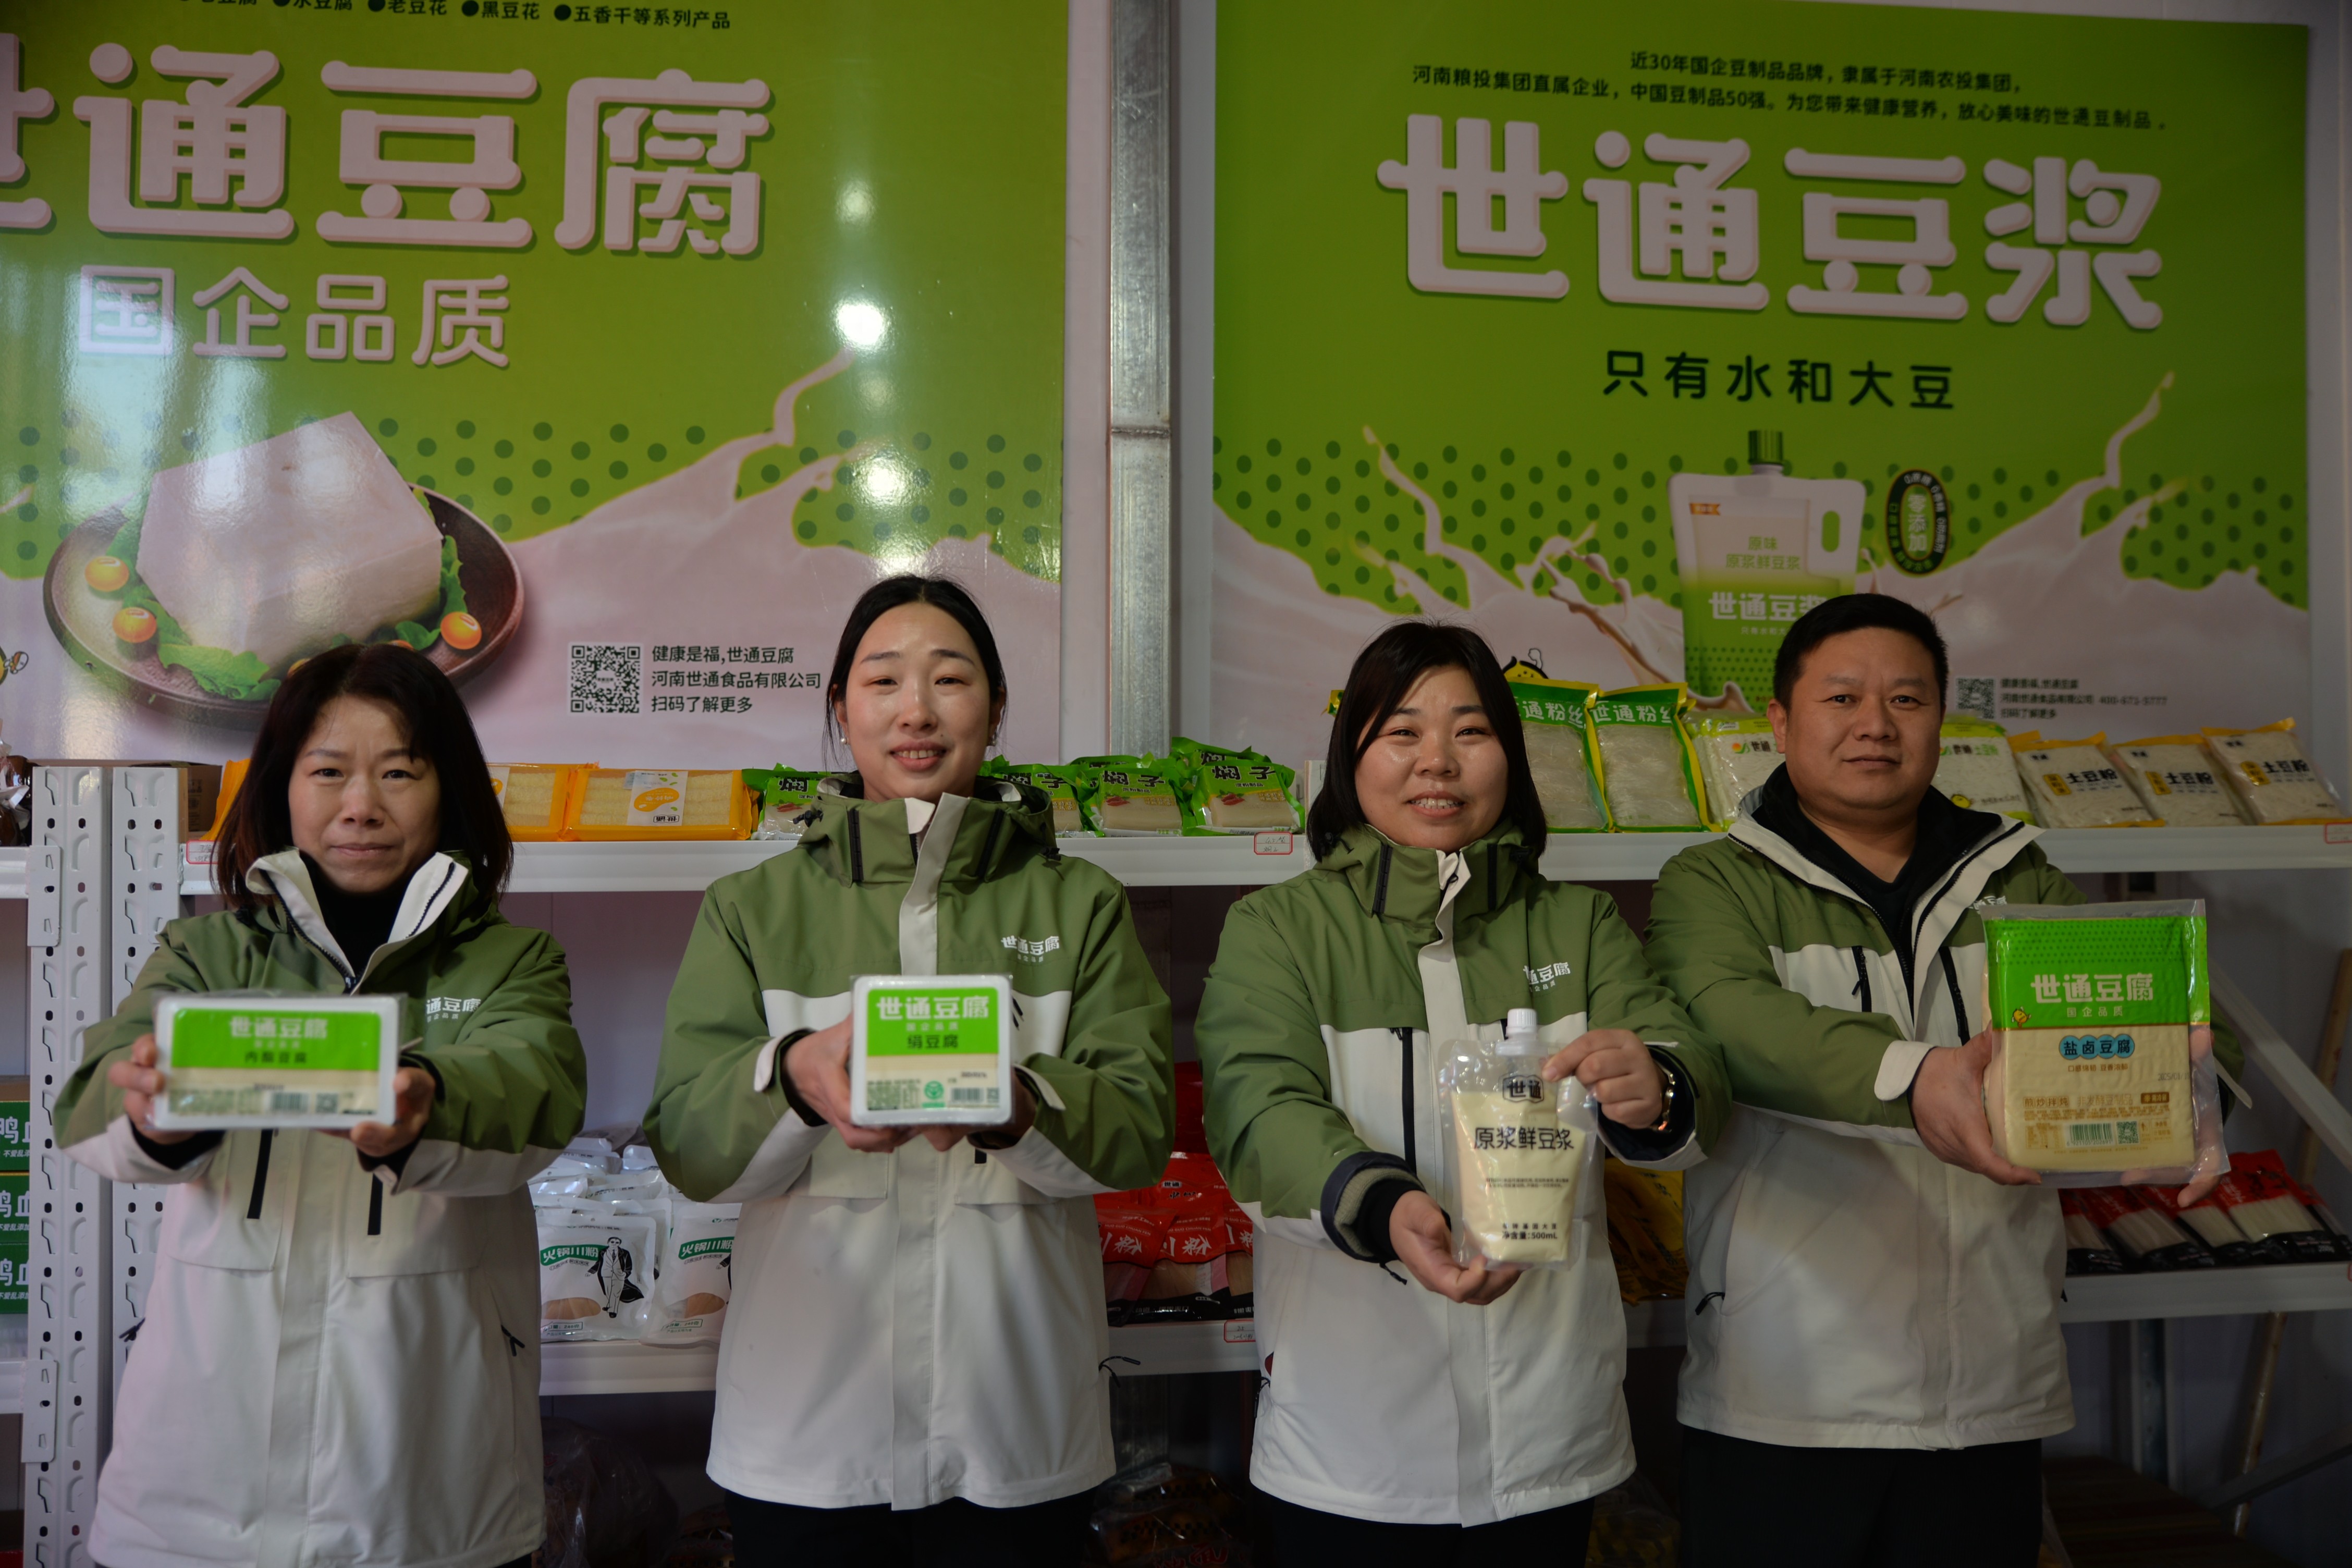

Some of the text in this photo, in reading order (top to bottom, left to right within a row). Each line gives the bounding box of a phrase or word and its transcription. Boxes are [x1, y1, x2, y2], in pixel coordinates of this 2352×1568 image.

[388, 0, 447, 15] 老豆花
[481, 1, 540, 20] 黑豆花
[574, 5, 730, 29] 五香干等系列产品
[0, 33, 770, 255] 通豆腐
[1377, 113, 2163, 329] 世通豆浆
[79, 265, 509, 367] 国企品质
[1603, 350, 1954, 409] 只有水和大豆
[1907, 494, 1927, 552] 零添加
[1748, 536, 1778, 550] 原味
[1725, 553, 1800, 570] 原浆鲜豆浆
[1741, 627, 1789, 635] 只有水和大
[652, 645, 794, 665] 健康是福,世通豆腐
[652, 670, 822, 690] 河南世通食品有限公司
[652, 696, 753, 714] 扫码了解更多
[1516, 701, 1584, 728] 通粉丝
[1211, 765, 1276, 780] 焖子
[2066, 768, 2120, 784] 土豆粉
[2263, 759, 2311, 774] 土豆粉
[1101, 770, 1166, 788] 焖子
[2165, 771, 2214, 785] 土豆粉
[1000, 935, 1060, 956] 世通豆腐
[1534, 980, 1555, 992] 企品质
[2030, 972, 2153, 1004] 世通豆腐
[876, 995, 989, 1020] 世通豆腐
[2067, 1006, 2123, 1018] 国企品质
[229, 1015, 328, 1039] 世通豆腐
[2064, 1039, 2131, 1056] 盐卤豆腐
[1506, 1080, 1542, 1099] 世通
[2025, 1096, 2069, 1107] 煎炒拌炖
[2077, 1093, 2133, 1107] 非发酵豆制品
[1474, 1126, 1574, 1150] 原浆鲜豆浆
[543, 1246, 598, 1263] 火锅川粉
